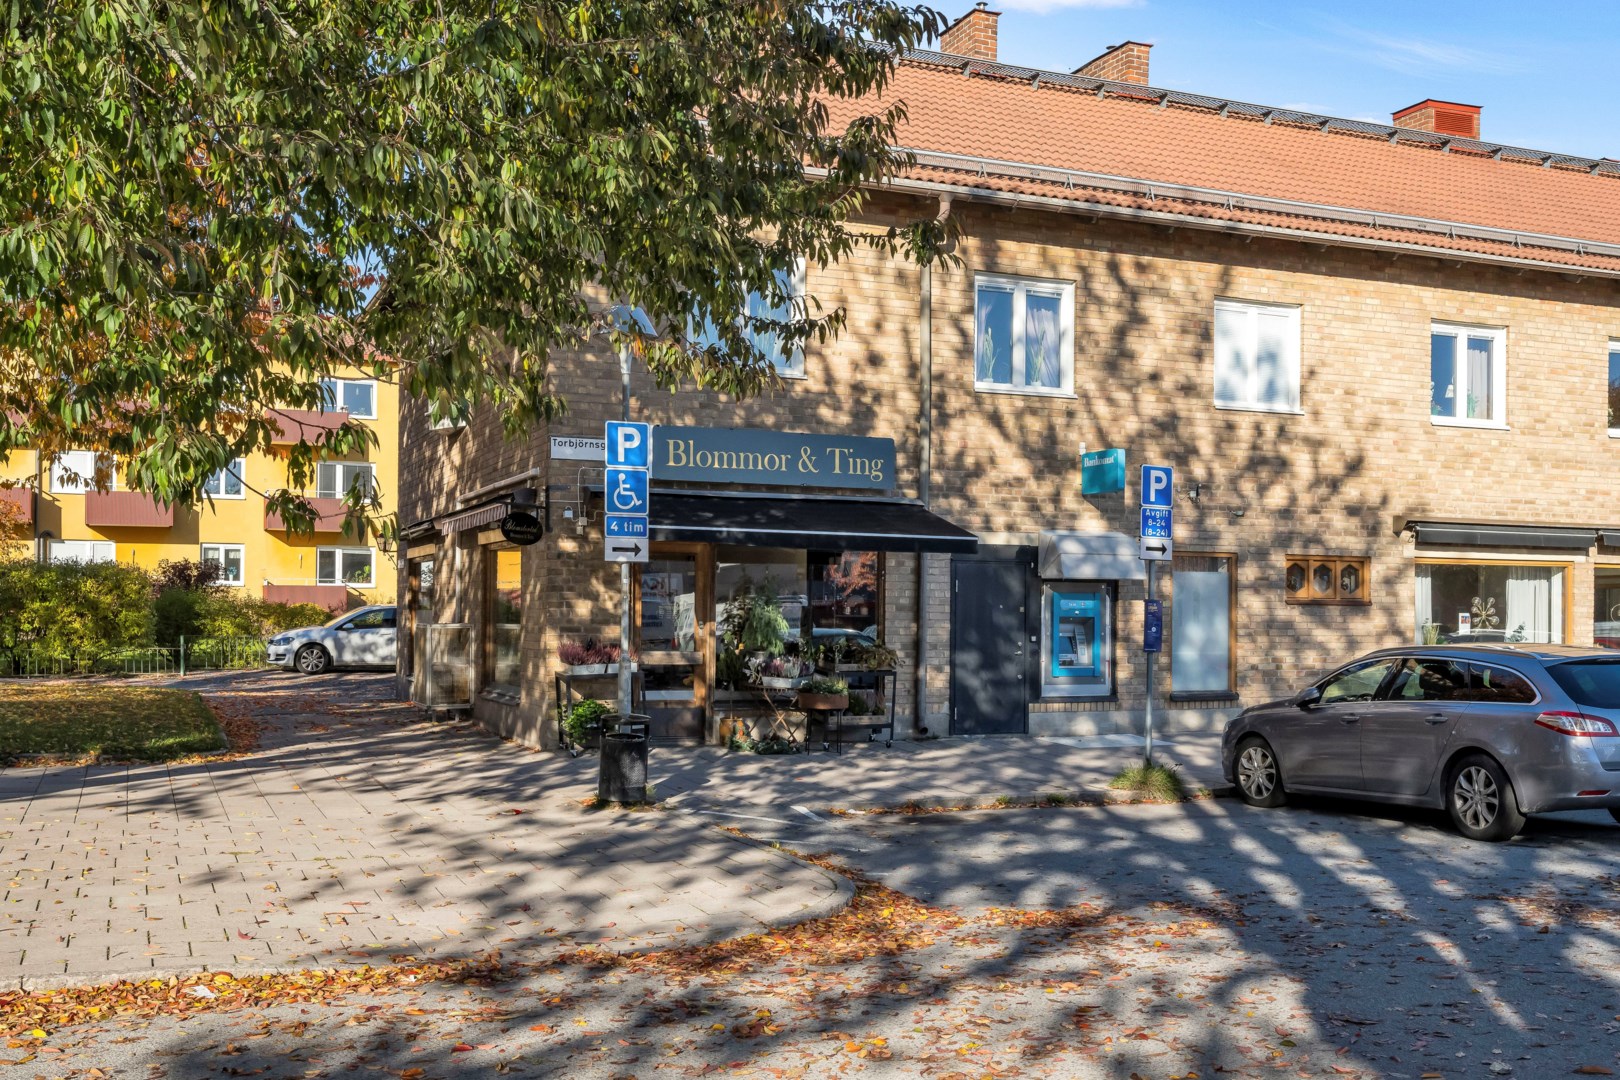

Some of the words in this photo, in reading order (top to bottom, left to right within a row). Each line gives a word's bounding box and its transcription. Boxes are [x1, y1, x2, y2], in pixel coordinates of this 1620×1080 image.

[618, 426, 641, 462] P
[666, 439, 791, 472] Blommor
[798, 446, 819, 473] &
[826, 447, 884, 482] Ting
[1084, 454, 1115, 467] Bankomat
[1150, 470, 1168, 501] P
[1145, 508, 1168, 518] Avgift
[610, 521, 619, 532] 4
[623, 521, 644, 533] tim
[1148, 518, 1166, 526] 8-24
[1145, 527, 1168, 537] (8-24)
